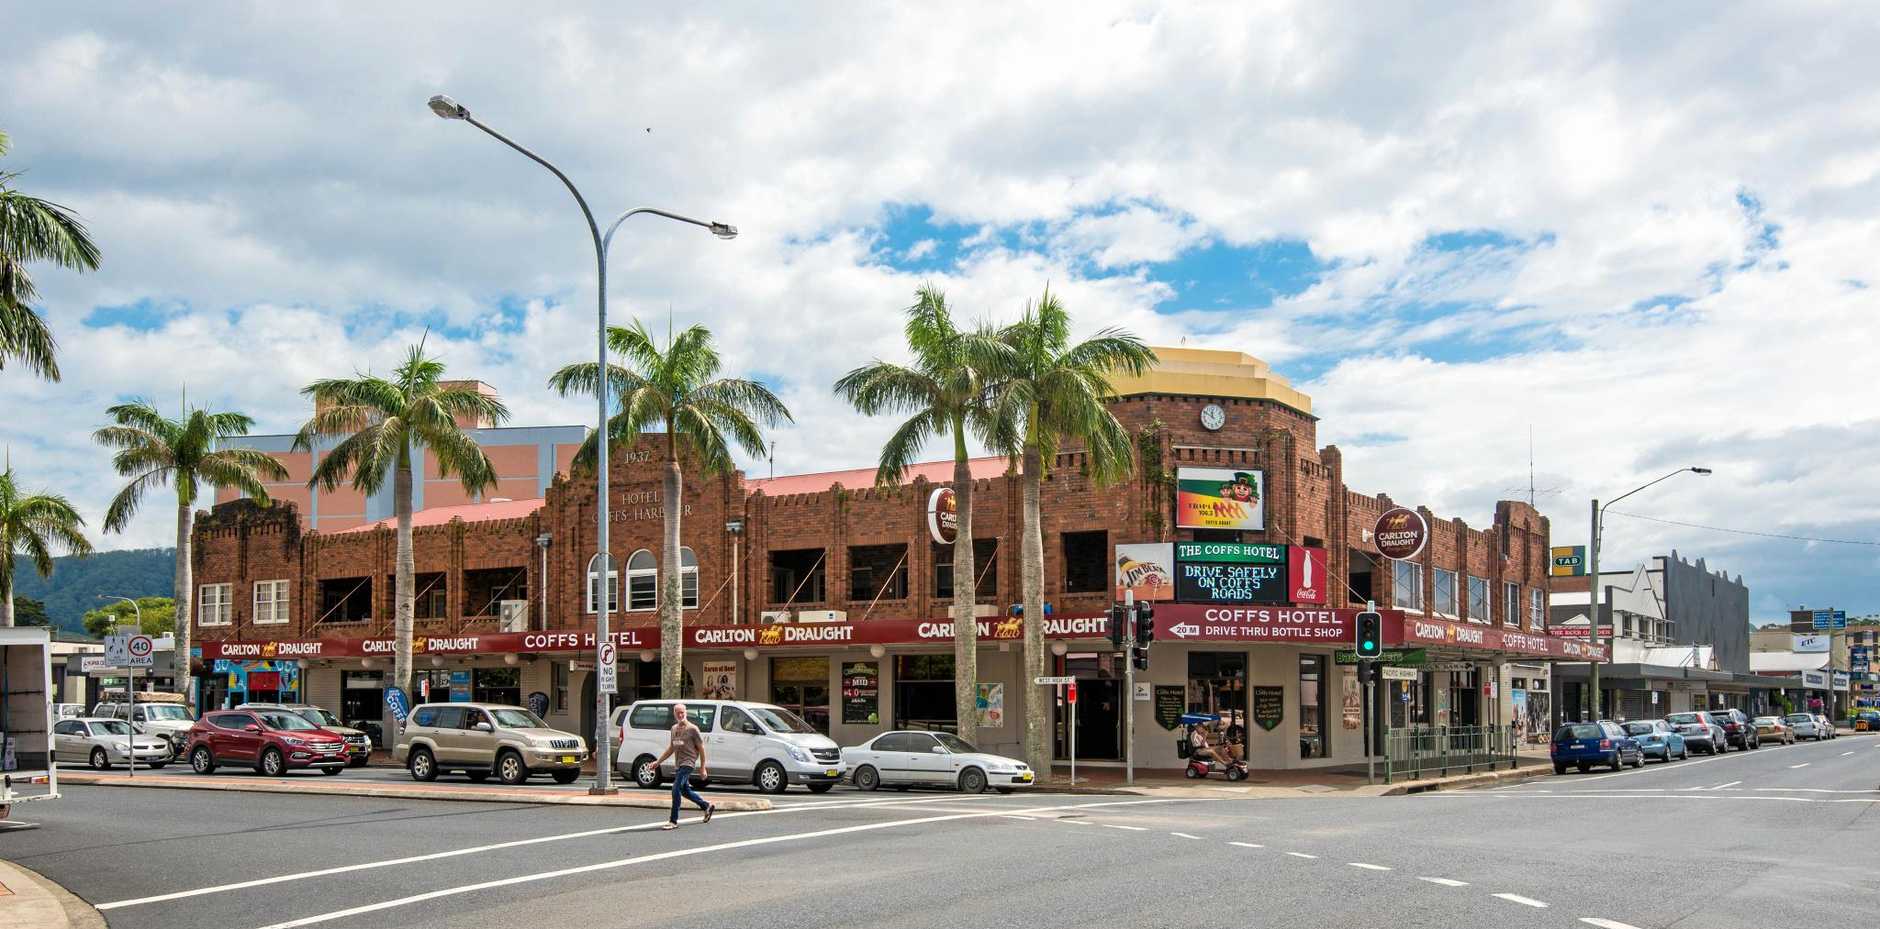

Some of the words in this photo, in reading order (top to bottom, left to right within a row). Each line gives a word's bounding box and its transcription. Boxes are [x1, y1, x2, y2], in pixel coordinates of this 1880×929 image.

[624, 450, 651, 464] 1937
[622, 490, 661, 505] HOTEL
[592, 509, 628, 523] CFFS
[940, 512, 957, 522] CARL
[1378, 531, 1418, 541] CARLTON
[1381, 538, 1415, 548] DRAUGHT
[1179, 545, 1202, 558] THE
[1205, 545, 1240, 555] COFFS
[1244, 546, 1280, 560] HOTEL
[1558, 557, 1579, 565] TAB
[1127, 568, 1142, 587] JIM
[1185, 565, 1223, 578] DRIVE
[1227, 566, 1277, 579] SAFELY
[1198, 577, 1215, 588] ON
[1219, 577, 1261, 589] COFFS
[1211, 588, 1253, 600] ROADS
[1205, 609, 1270, 623] COFFS
[1278, 611, 1343, 625] HOTEL
[695, 628, 755, 644] CARLTON
[784, 625, 854, 641] DRAUGHT
[918, 622, 989, 638] CARLN
[1042, 617, 1107, 634] RAUGHT
[1176, 626, 1187, 634] 20
[1205, 626, 1237, 636] DRIVE
[1240, 626, 1269, 637] THRU
[1272, 627, 1312, 637] BOTTLE
[1314, 627, 1343, 638] SHOP
[1415, 622, 1445, 640] CARLTON
[1456, 627, 1483, 644] DRAUGHT
[133, 642, 148, 651] 40
[428, 637, 480, 651] DRAUGHT
[525, 633, 579, 648] COFFS
[585, 631, 642, 646] HTEL
[1503, 634, 1526, 648] COFFS
[1527, 637, 1549, 652] HOTEL
[221, 644, 260, 656] CARLTON
[278, 642, 323, 655] DRAUGHT
[129, 657, 152, 665] AREA
[602, 667, 613, 675] NO
